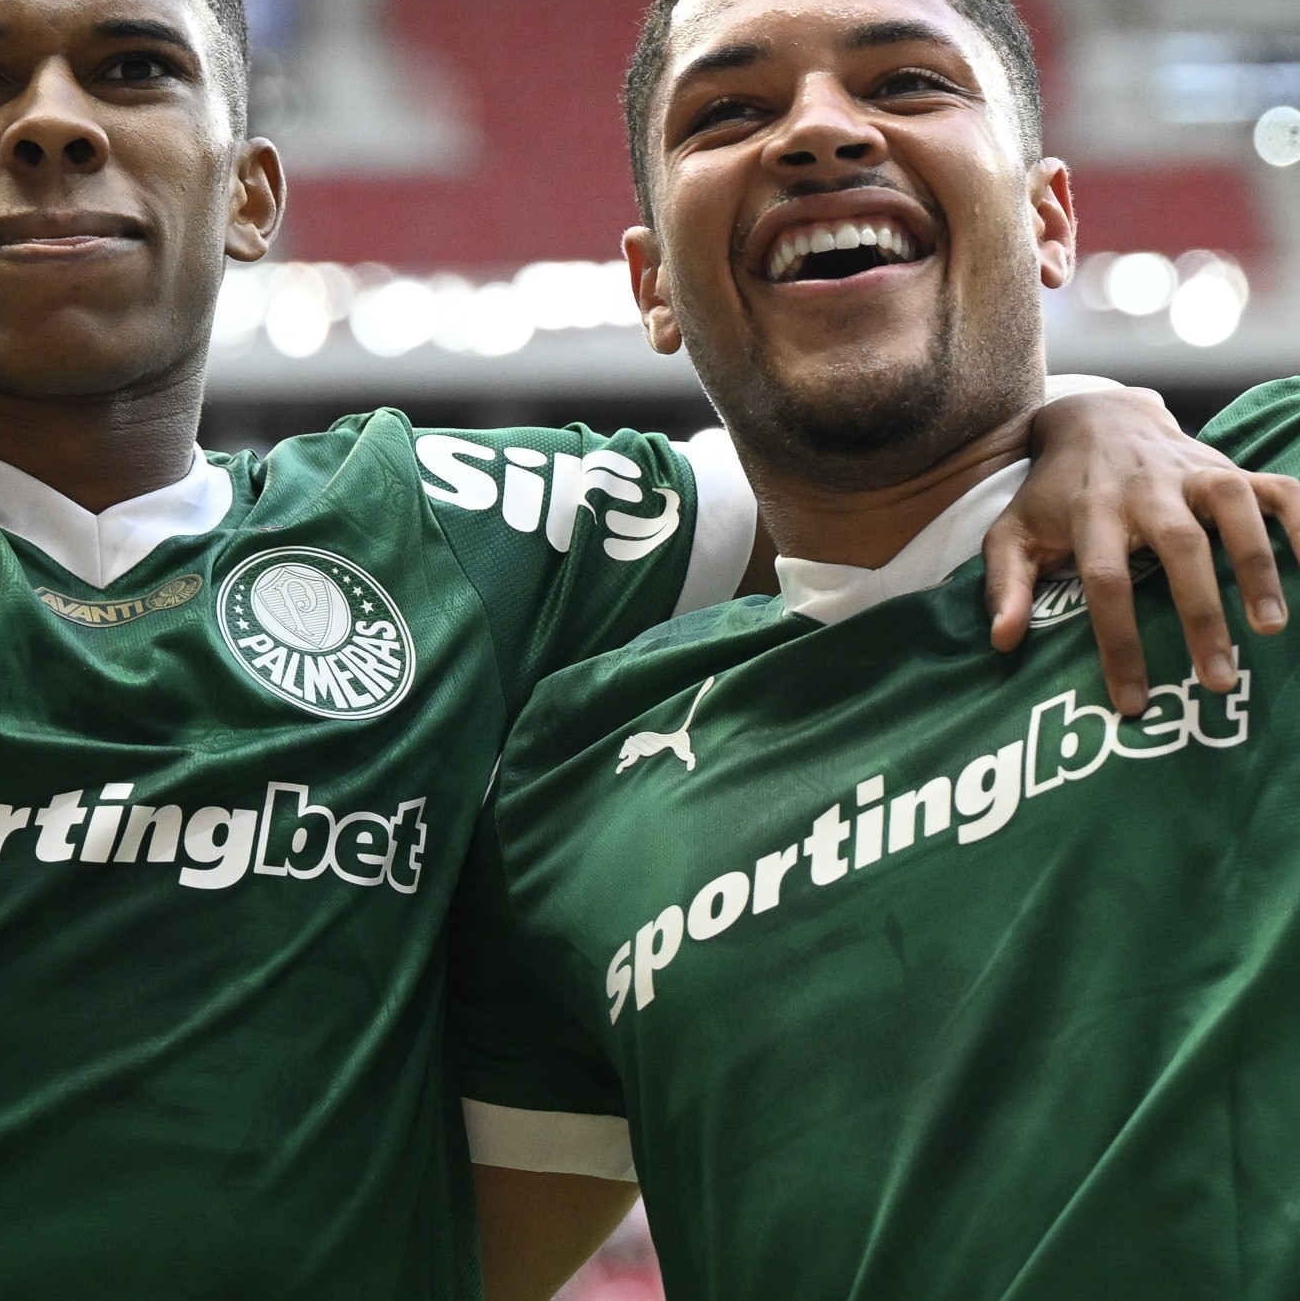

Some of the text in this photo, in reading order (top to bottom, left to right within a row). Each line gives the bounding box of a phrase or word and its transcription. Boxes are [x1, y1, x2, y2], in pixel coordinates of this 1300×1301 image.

[40, 594, 144, 623] AVANTI
[237, 620, 401, 709] PALMEIRAS
[607, 645, 1251, 1024] sportingbet
